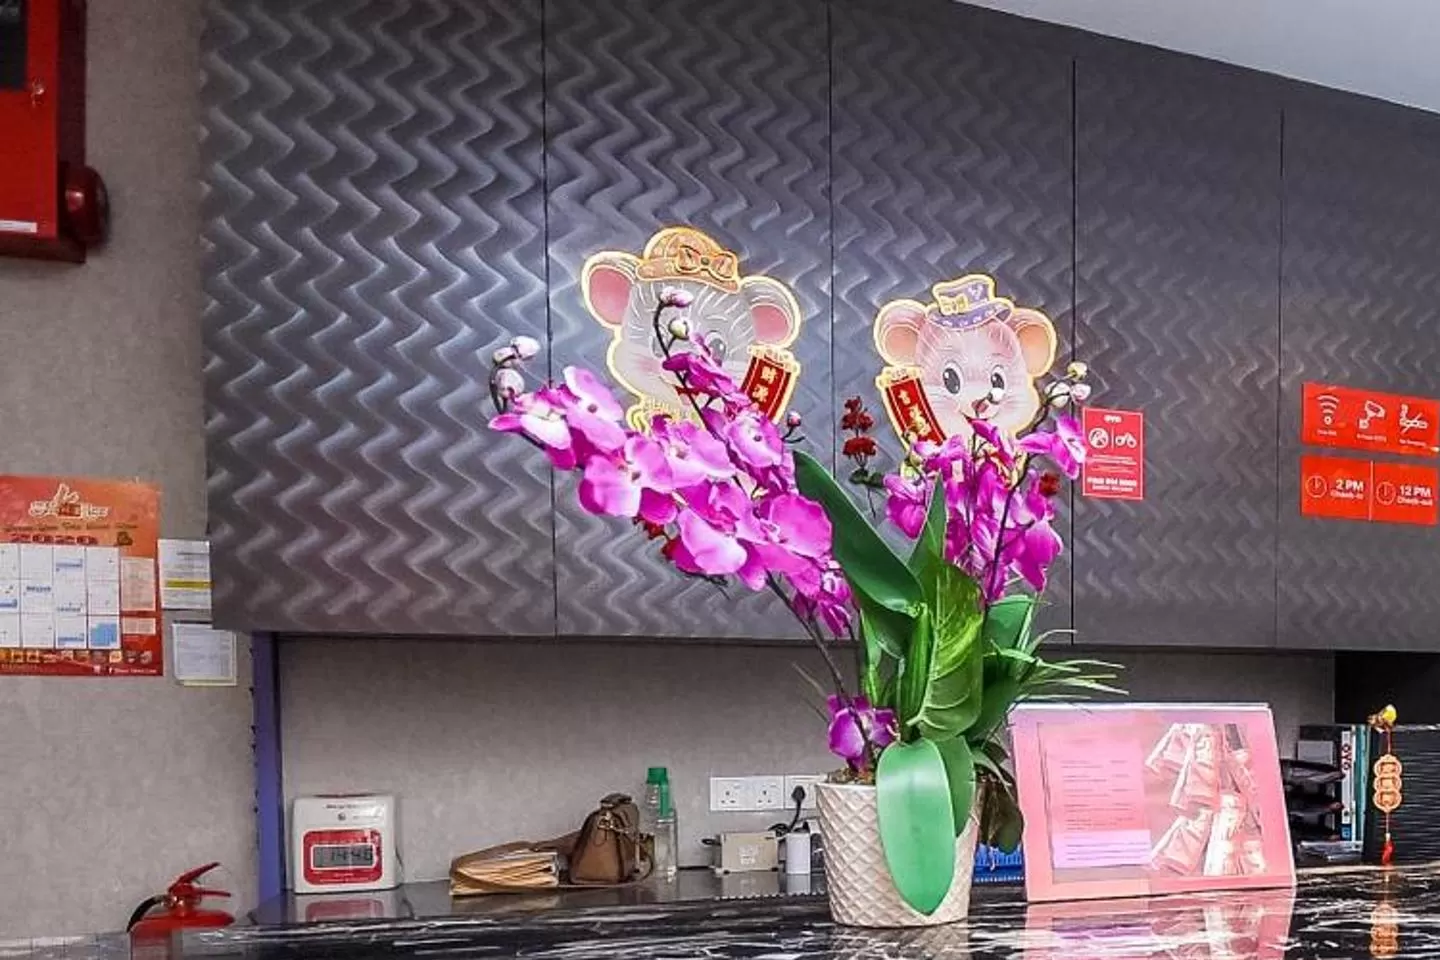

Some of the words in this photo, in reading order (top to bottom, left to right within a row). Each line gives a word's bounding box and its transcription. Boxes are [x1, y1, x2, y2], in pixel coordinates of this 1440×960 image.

[1335, 478, 1343, 490] 2
[1345, 479, 1364, 492] PM
[1400, 484, 1412, 496] 12
[1413, 486, 1432, 498] PM
[1341, 743, 1352, 771] OYO
